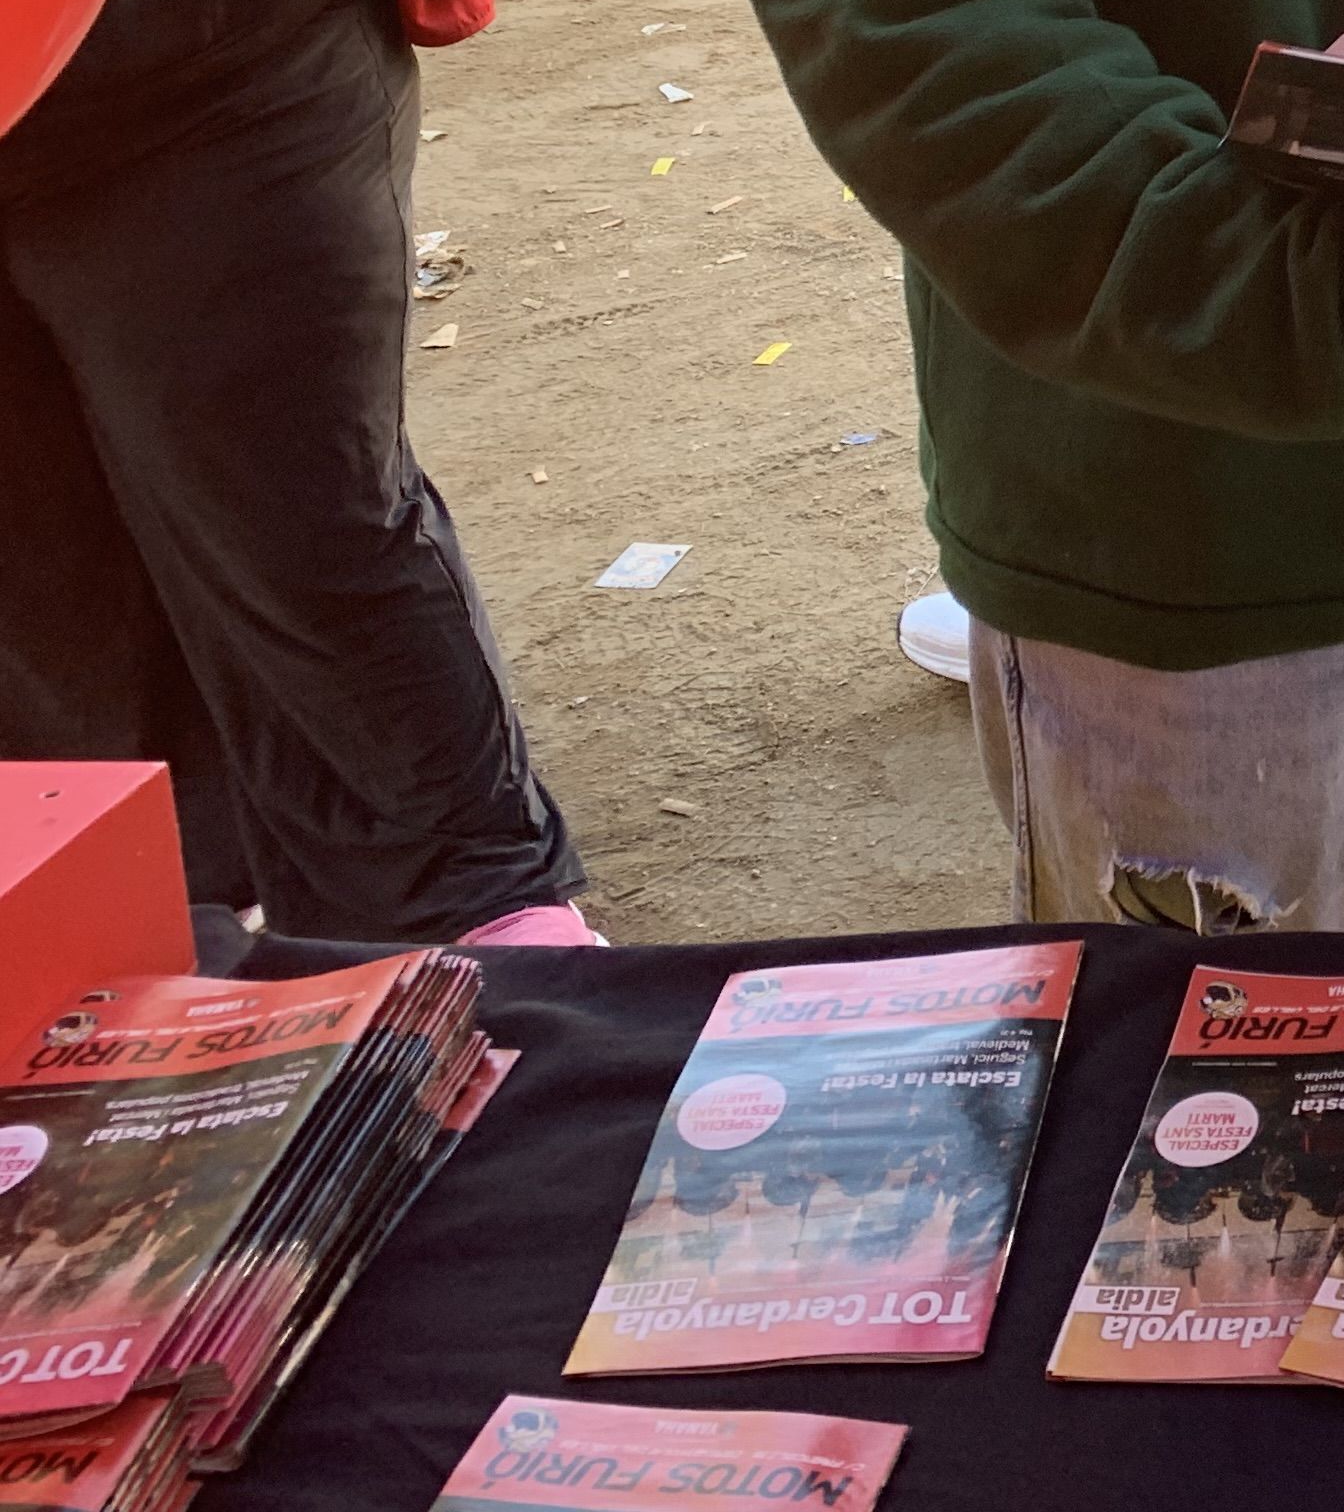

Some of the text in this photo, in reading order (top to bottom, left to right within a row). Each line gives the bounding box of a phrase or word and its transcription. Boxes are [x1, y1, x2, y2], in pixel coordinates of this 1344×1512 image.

[886, 979, 1047, 1016] MOTOS
[22, 1003, 353, 1080] MOTOS FURIÓ
[1198, 1017, 1335, 1049] FURIÓ
[821, 1069, 1023, 1091] Esclata la Festa!
[196, 1101, 288, 1129] Esclata
[1186, 1112, 1236, 1127] MARTÍ
[83, 1124, 168, 1146] Festa!
[1162, 1125, 1253, 1139] FESTA SANT
[1167, 1138, 1239, 1151] ESPECIAL
[614, 1288, 971, 1340] TOT Cerdanyola
[33, 1338, 132, 1379] TOT
[482, 1449, 854, 1505] MOTOS FURIÓ
